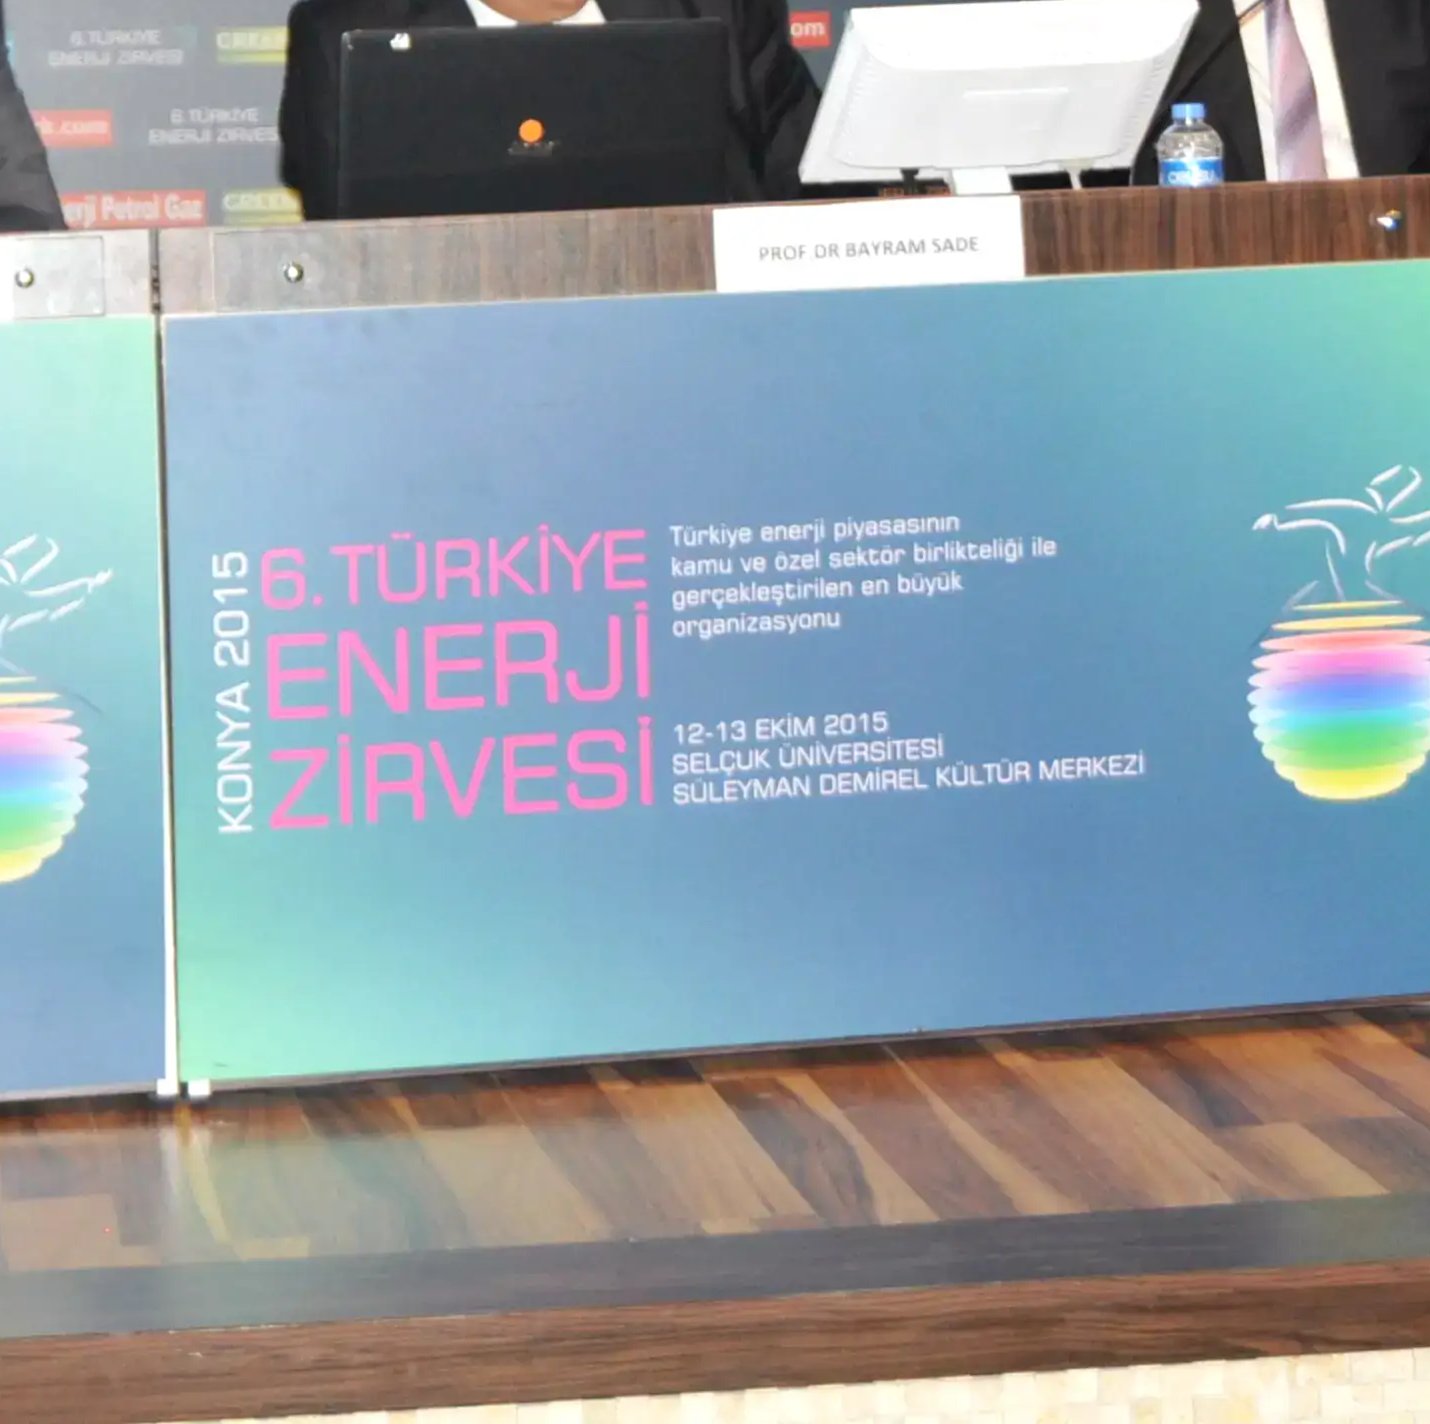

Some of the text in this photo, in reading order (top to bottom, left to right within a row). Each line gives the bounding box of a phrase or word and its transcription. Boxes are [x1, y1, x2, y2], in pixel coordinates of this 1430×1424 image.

[101, 193, 159, 223] Petrol
[165, 193, 203, 220] Gaz
[846, 240, 926, 257] BAYRAM
[931, 236, 980, 253] SADE
[670, 515, 961, 549] Türkiye enerji piyasasının
[670, 537, 1057, 577] kamu ve özel sektör birlikteliği ile
[671, 572, 964, 612] gerçekleştirilen en büyük
[671, 611, 841, 641] organizasyonu
[266, 600, 650, 720] ENERJİ
[211, 551, 254, 834] KONYA 2015
[672, 711, 889, 745] 12-13 EKİM 2015
[269, 716, 654, 830] ZİRVESİ
[672, 733, 943, 775] SELÇUK ÜNİVERSİTESİ
[673, 750, 1145, 805] SÜLEYMAN DEMİREL KÜLTÜR MERKEZİ
